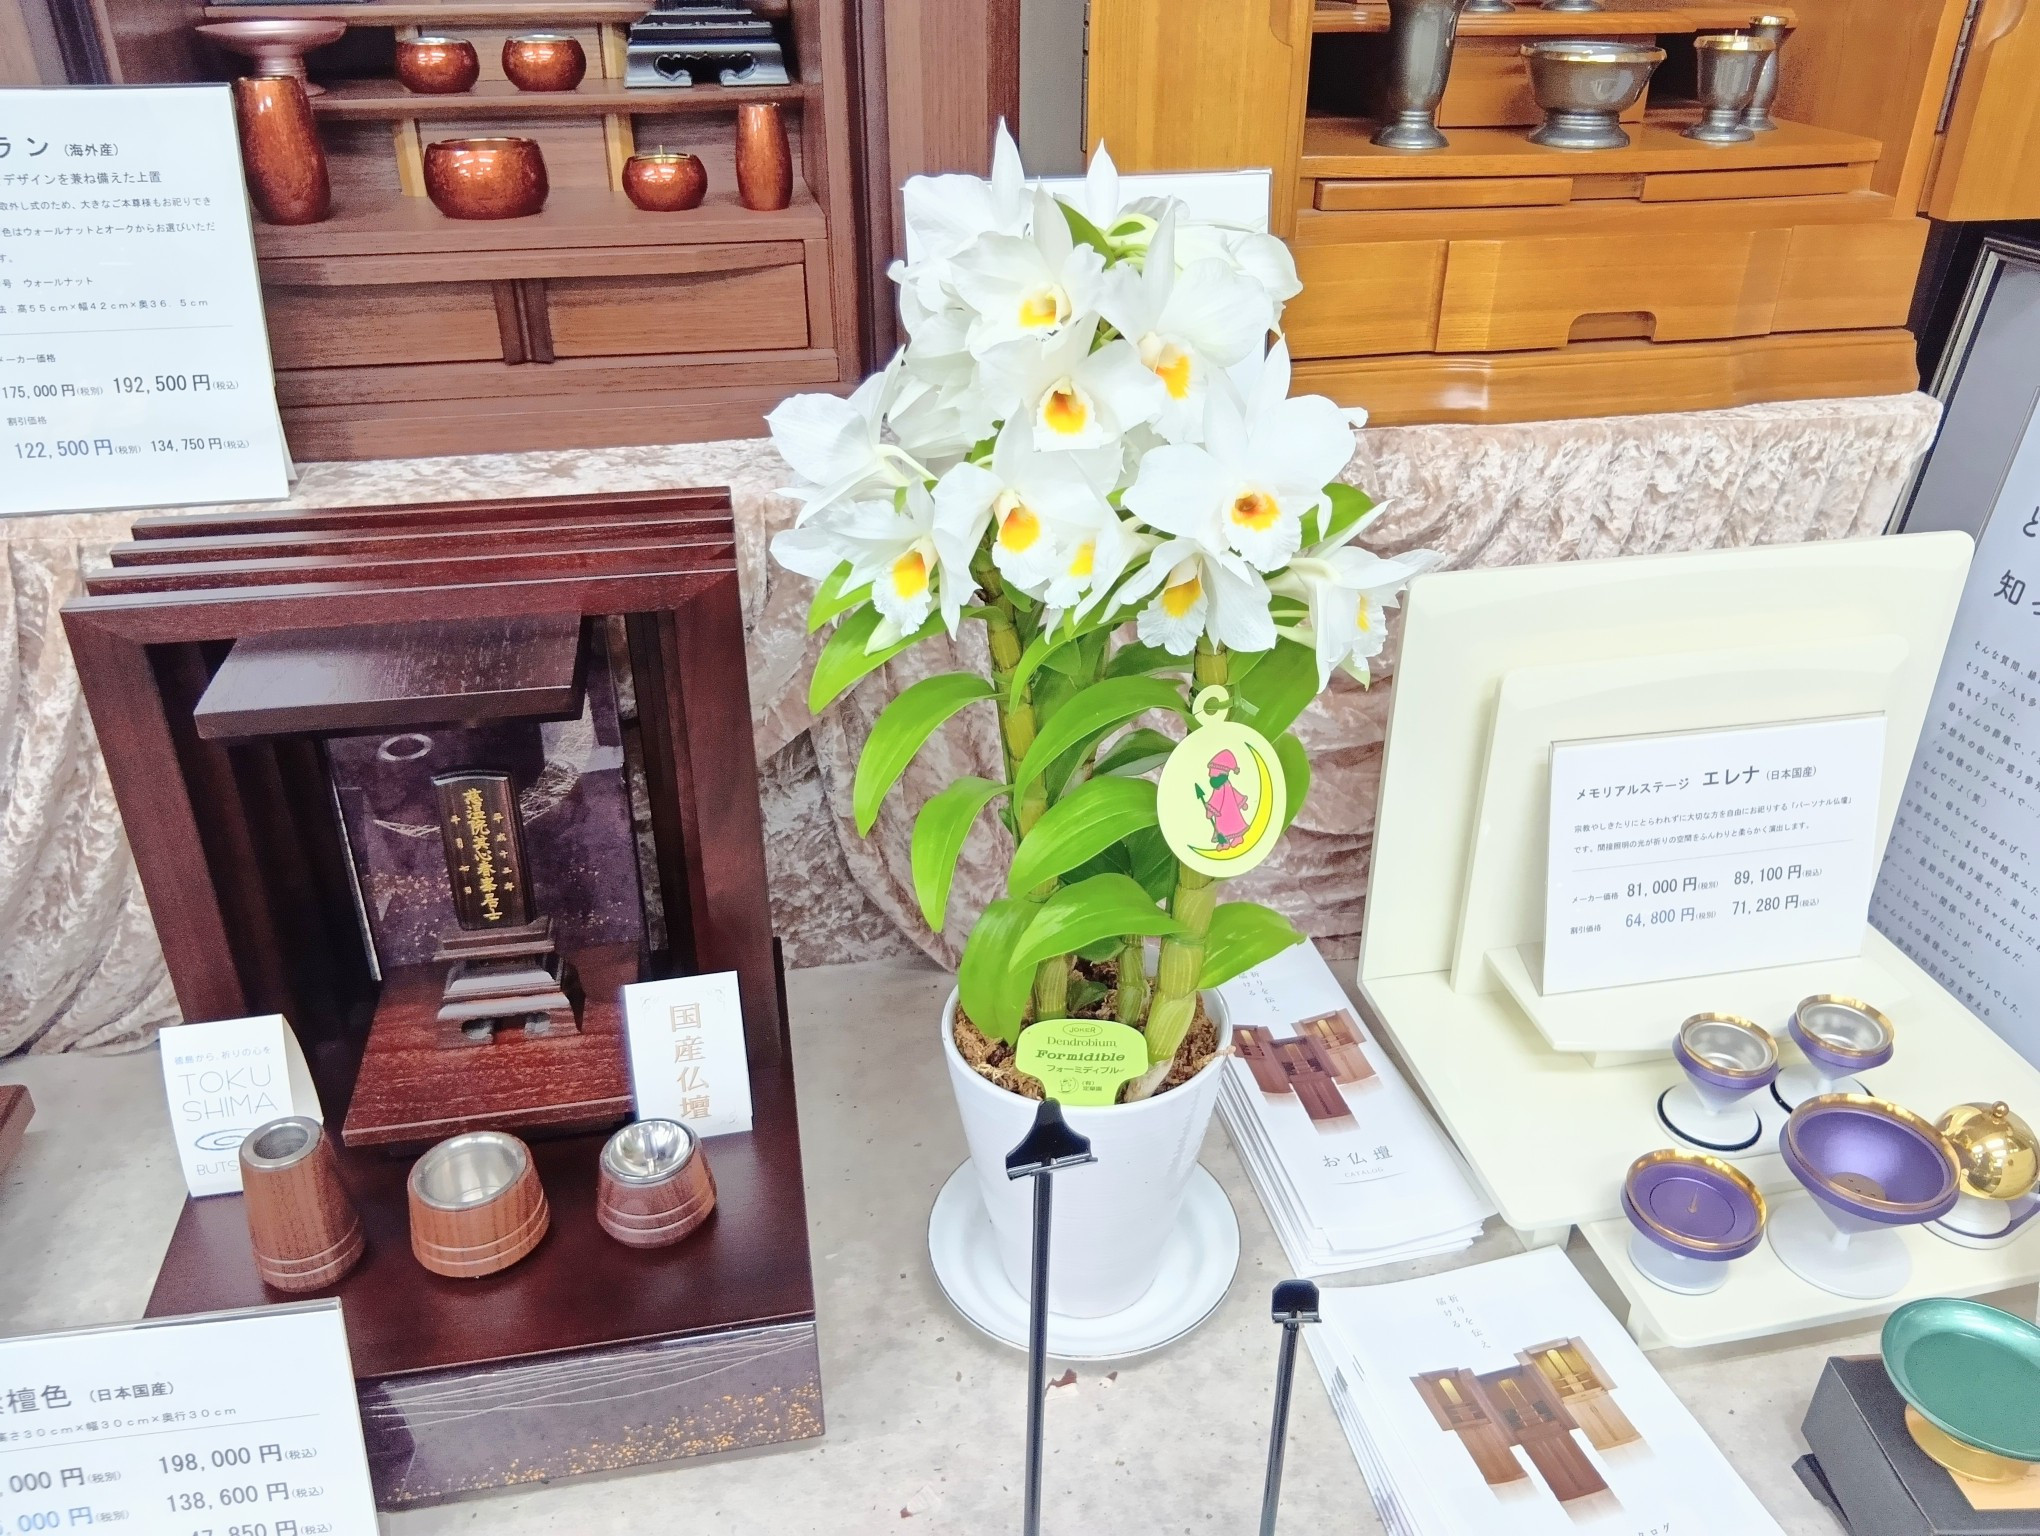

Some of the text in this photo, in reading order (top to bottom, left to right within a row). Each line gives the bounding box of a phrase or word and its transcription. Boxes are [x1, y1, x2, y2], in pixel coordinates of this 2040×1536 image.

[64, 142, 119, 157] (海外産)
[0, 353, 56, 364] ーカー価格
[7, 416, 48, 427] 割引価格
[1576, 765, 1817, 801] メモリアルステージ エレナ (日本国産)
[1047, 1036, 1118, 1048] Dendrobium
[669, 1002, 713, 1120] 国産仏壇
[1036, 1050, 1126, 1062] Formidible
[177, 1064, 272, 1096] TOKU
[182, 1091, 278, 1122] SHIMA
[1322, 1145, 1393, 1168] お仏壇
[0, 1381, 175, 1415] 檀色 (日本国産)
